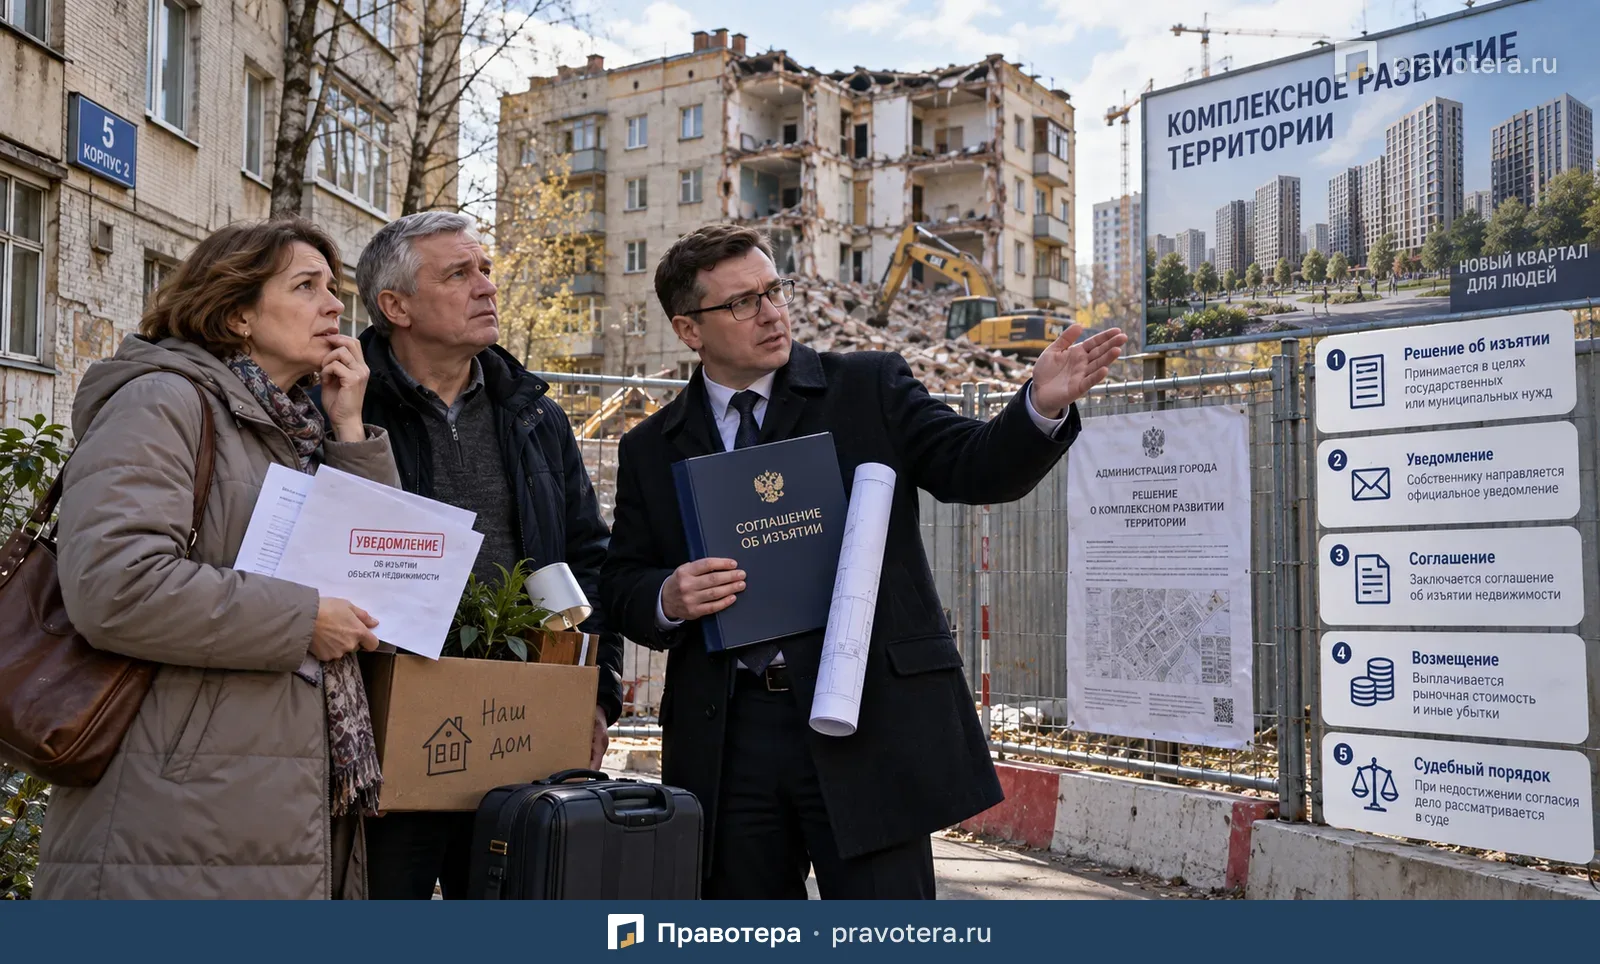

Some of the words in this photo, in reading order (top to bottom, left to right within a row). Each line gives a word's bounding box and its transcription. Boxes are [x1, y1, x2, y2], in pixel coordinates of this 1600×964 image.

[1168, 72, 1349, 138] КОМПЛЕКСНОЕ
[1358, 31, 1518, 95] РАЗВИТИЕ
[102, 116, 114, 148] 5
[1168, 112, 1334, 170] ТЕРРИТОРИИ
[84, 143, 121, 174] КОРПУС
[124, 163, 130, 178] 2
[1459, 248, 1513, 274] НОВЫЙ
[1517, 243, 1589, 267] КВАРТАЛ
[1466, 274, 1498, 295] ДЛЯ
[1502, 265, 1558, 289] ЛЮДЕЙ
[1404, 342, 1464, 361] Решение
[1469, 338, 1486, 353] об
[1490, 333, 1550, 351] изъятии
[1333, 353, 1339, 366] 1
[1404, 363, 1479, 380] Принимается
[1482, 364, 1488, 372] в
[1492, 358, 1526, 372] целях
[1405, 376, 1503, 396] государственных
[1405, 400, 1425, 410] или
[1428, 392, 1518, 408] муниципальных
[1522, 388, 1552, 400] нужд
[1334, 453, 1342, 466] 2
[1407, 450, 1494, 466] Уведомление
[1096, 466, 1176, 479] АДМИНИСТРАЦИЯ
[1179, 464, 1217, 475] ГОРОДА
[1407, 473, 1482, 486] Собственнику
[1486, 468, 1564, 481] направляется
[1132, 490, 1178, 500] РЕШЕНИЕ
[1407, 489, 1480, 503] официальное
[1483, 484, 1559, 499] уведомление
[1090, 505, 1097, 515] О
[1099, 502, 1170, 515] КОМПЛЕКСНОМ
[1172, 502, 1224, 513] РАЗВИТИИ
[736, 507, 822, 535] СОГЛАШЕНИЕ
[1125, 517, 1187, 528] ТЕРРИТОРИИ
[356, 535, 439, 552] УВЕДОМЛЕНИЕ
[741, 536, 760, 549] ОБ
[763, 523, 823, 545] ИЗЪЯТИИ
[1335, 549, 1344, 562] 3
[1409, 552, 1496, 566] Соглашение
[348, 570, 380, 579] ОБЪЕКТА
[382, 572, 439, 581] НЕДВИЖИМОСТИ
[1410, 573, 1481, 586] Заключается
[1484, 573, 1554, 584] соглашение
[1410, 589, 1424, 600] об
[1426, 590, 1472, 601] изъятии
[1475, 590, 1561, 601] недвижимости
[1337, 646, 1345, 660] 4
[1412, 651, 1499, 668] Возмещение
[1412, 672, 1504, 687] Выплачивается
[1413, 690, 1469, 702] рыночная
[1472, 692, 1536, 704] стоимость
[482, 698, 526, 726] Наш
[1413, 706, 1420, 714] и
[1423, 706, 1453, 716] иные
[1456, 706, 1499, 720] убытки
[490, 734, 532, 760] дом
[1339, 747, 1347, 761] 5
[1414, 757, 1485, 777] Судебный
[1488, 766, 1550, 783] порядок
[1414, 779, 1436, 794] При
[1439, 784, 1522, 801] недостижении
[1525, 792, 1580, 807] согласия
[1415, 797, 1442, 809] дело
[1445, 801, 1545, 820] рассматривается
[1416, 814, 1422, 822] в
[1424, 815, 1449, 826] суде
